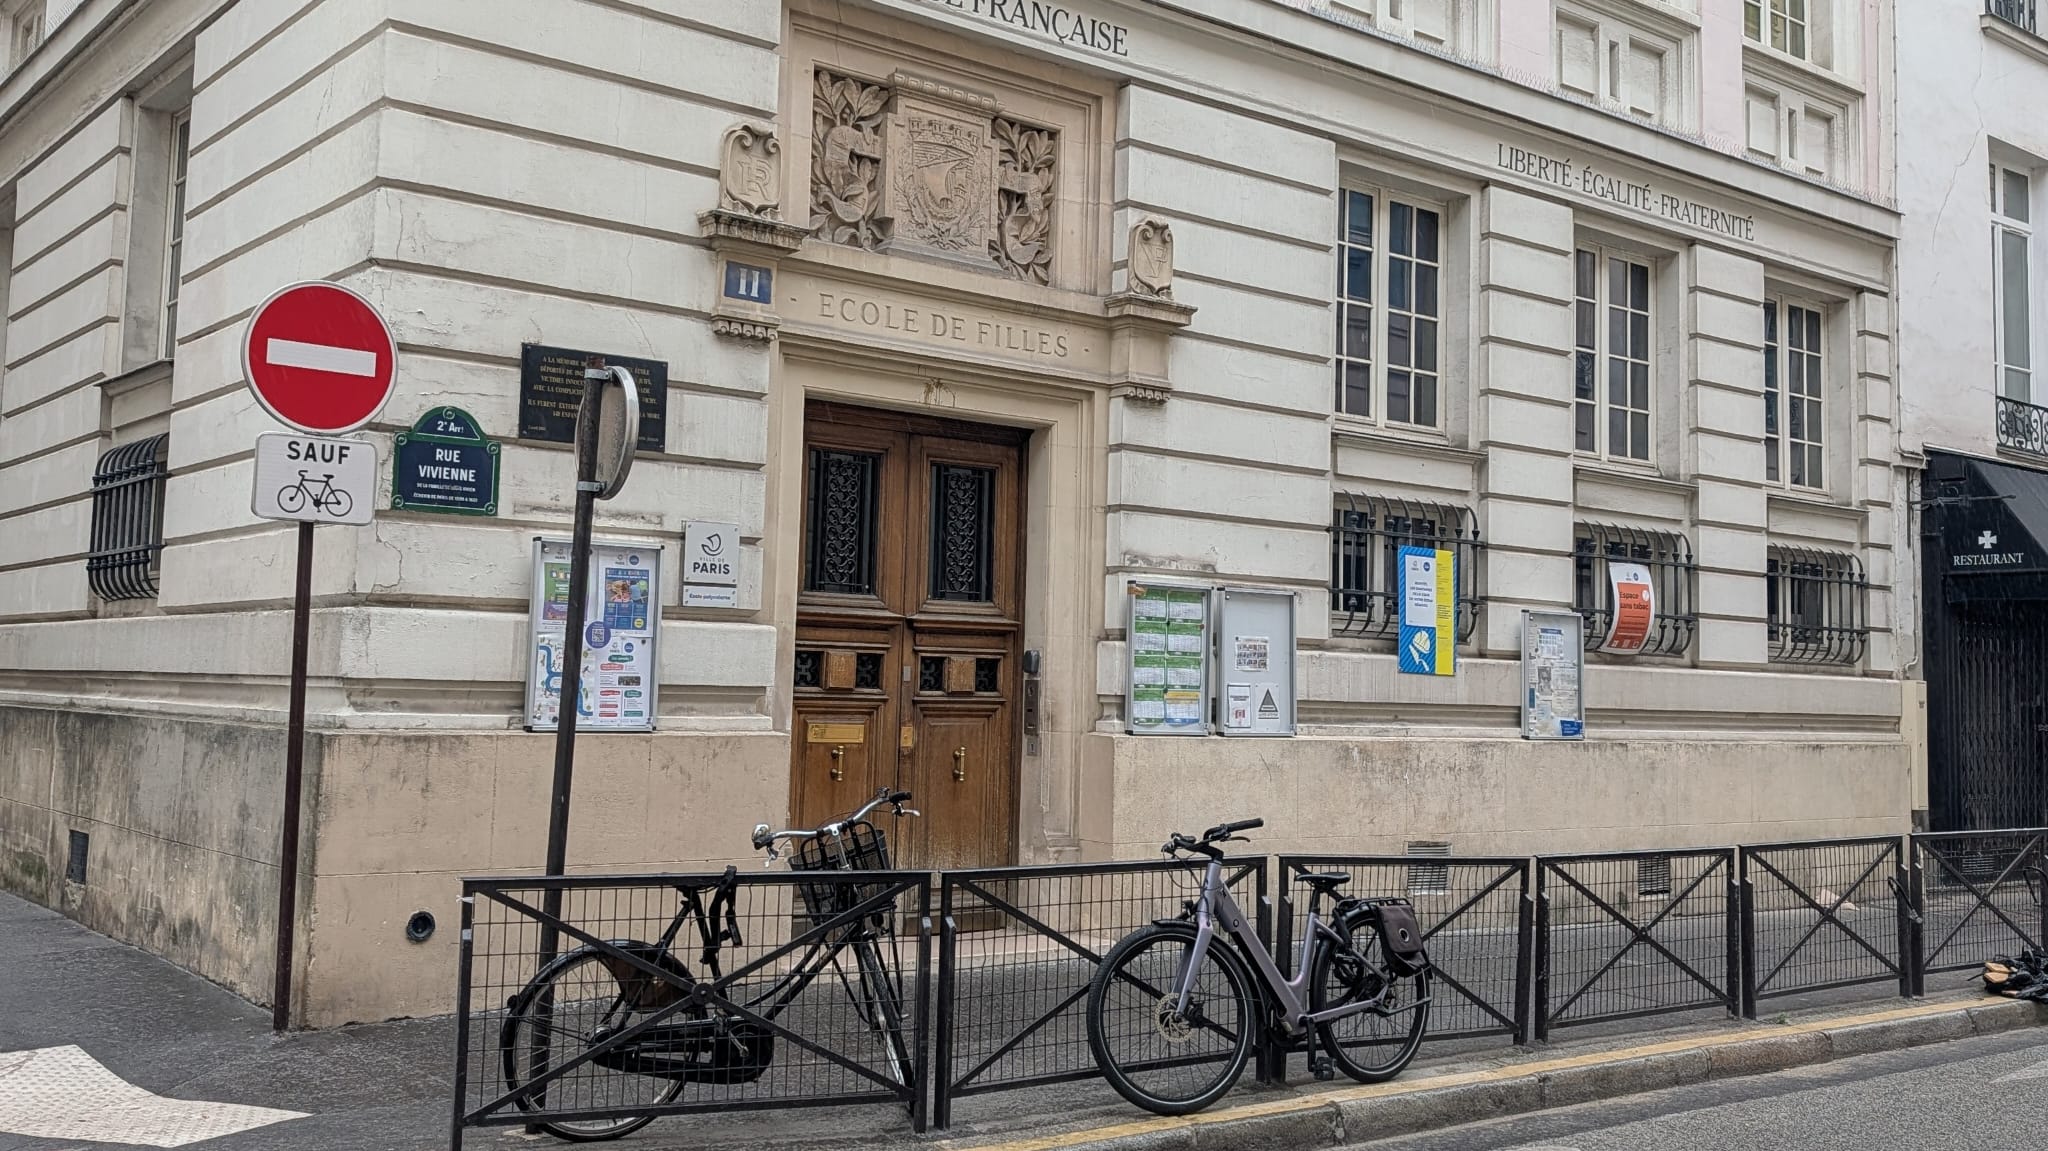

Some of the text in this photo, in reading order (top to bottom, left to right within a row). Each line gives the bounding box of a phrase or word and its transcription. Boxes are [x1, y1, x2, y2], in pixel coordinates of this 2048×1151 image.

[738, 268, 760, 298] 11
[818, 293, 1069, 358] ECOLE DE FILLES
[286, 440, 351, 465] SAUF
[435, 448, 461, 463] RUE
[418, 465, 477, 482] VIVIENNE
[1953, 552, 2024, 566] RESTAURANT
[693, 561, 730, 575] PARIS
